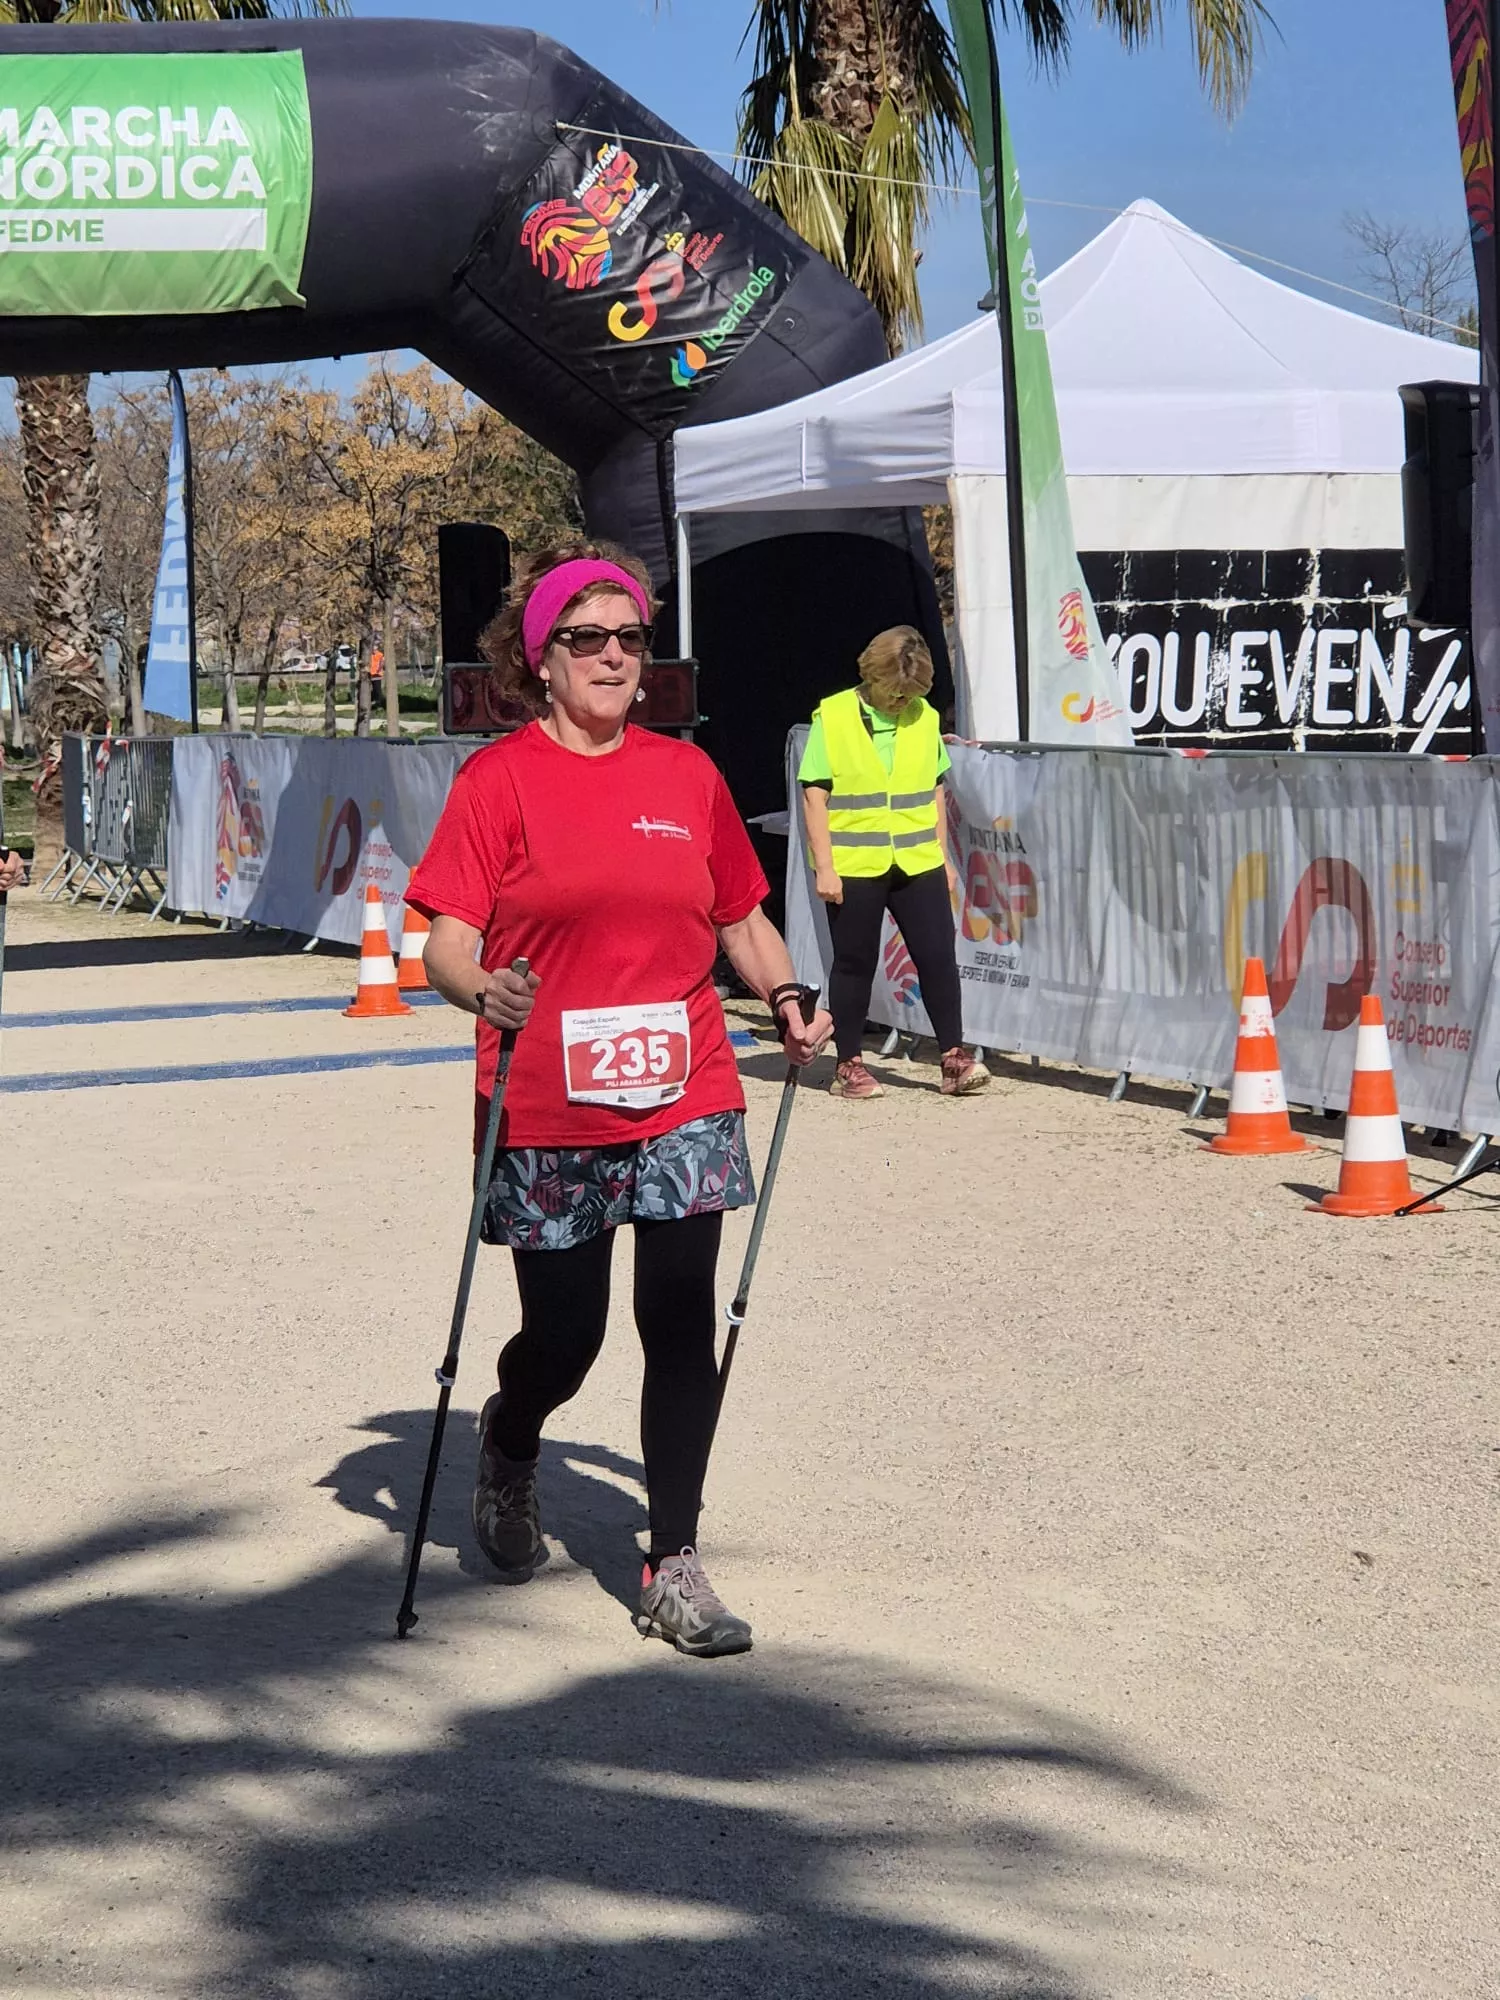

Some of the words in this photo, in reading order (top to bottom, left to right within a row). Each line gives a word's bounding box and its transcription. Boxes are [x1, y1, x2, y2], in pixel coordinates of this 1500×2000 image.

[1394, 930, 1446, 970] Consejo
[1390, 971, 1450, 1006] Superior
[1386, 1010, 1405, 1041] de
[1407, 1014, 1472, 1051] Deportes
[590, 1034, 671, 1080] 235
